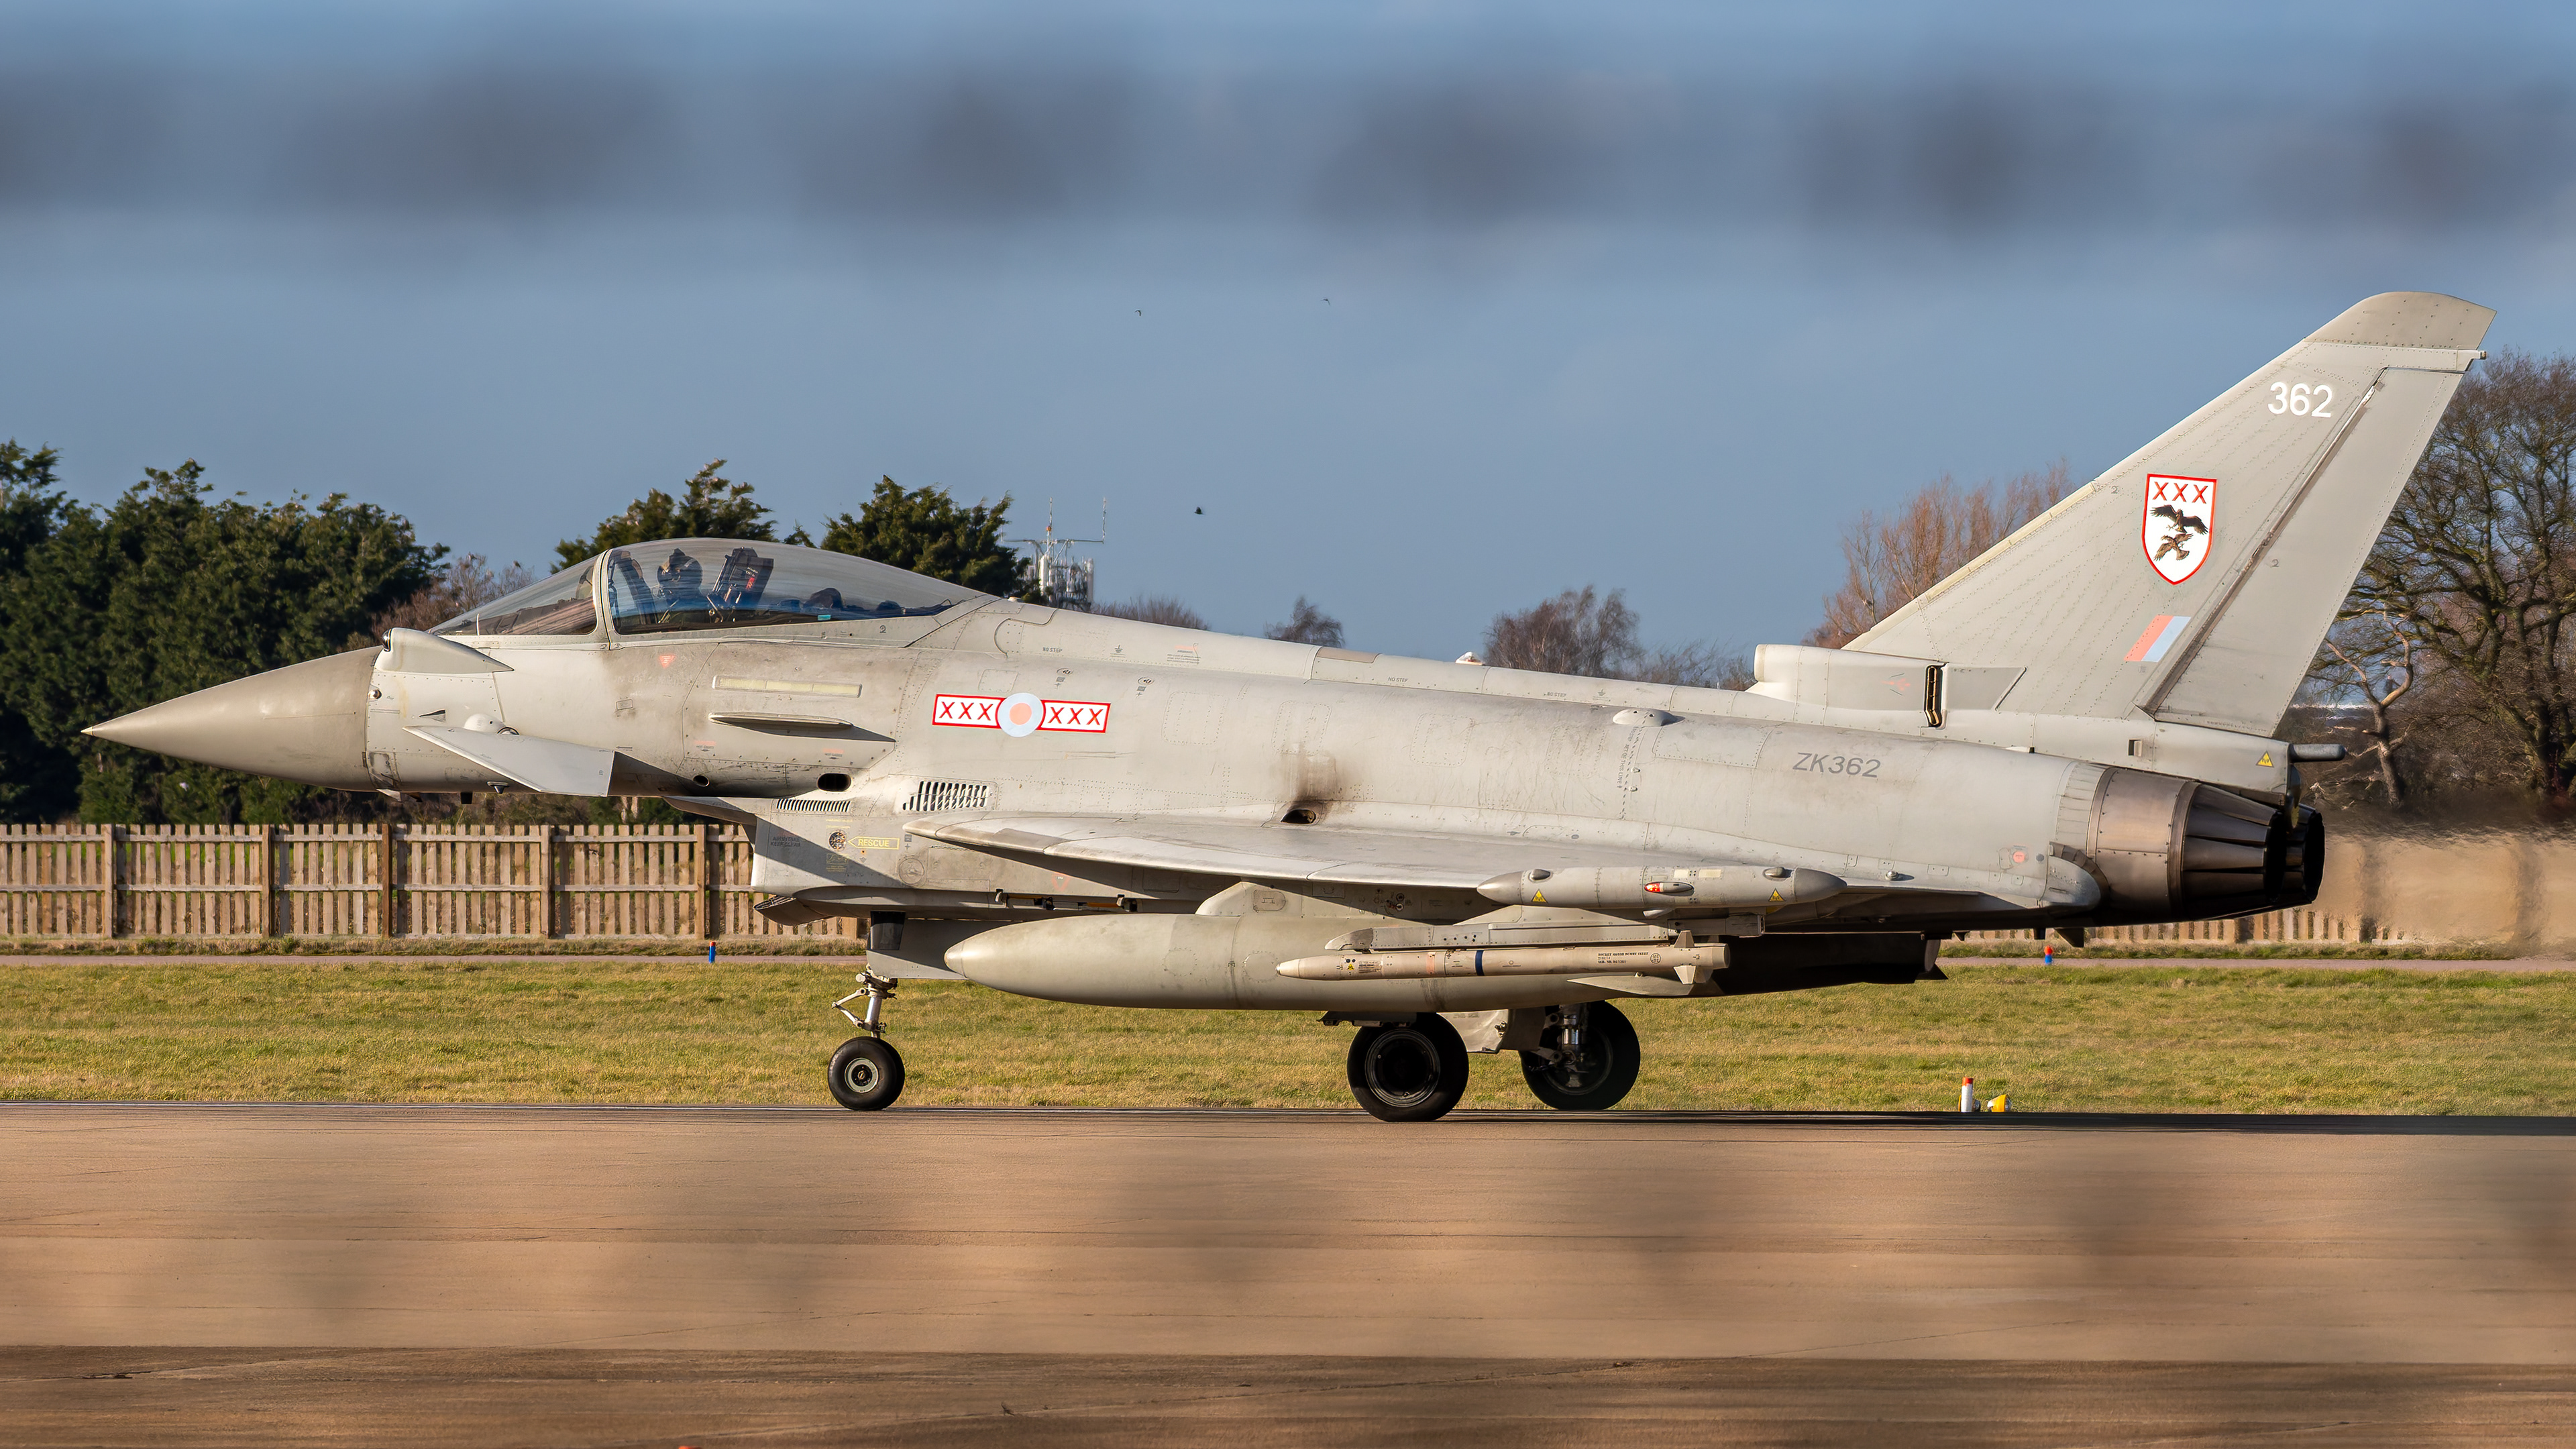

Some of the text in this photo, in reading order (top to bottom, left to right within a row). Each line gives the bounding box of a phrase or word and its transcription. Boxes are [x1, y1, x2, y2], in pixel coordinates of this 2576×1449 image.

[2268, 381, 2332, 418] 362
[2153, 481, 2208, 504] XXX
[939, 701, 994, 721] XXX
[1048, 706, 1104, 727] XXX
[1792, 752, 1881, 778] ZK362
[858, 839, 890, 847] RESCUE
